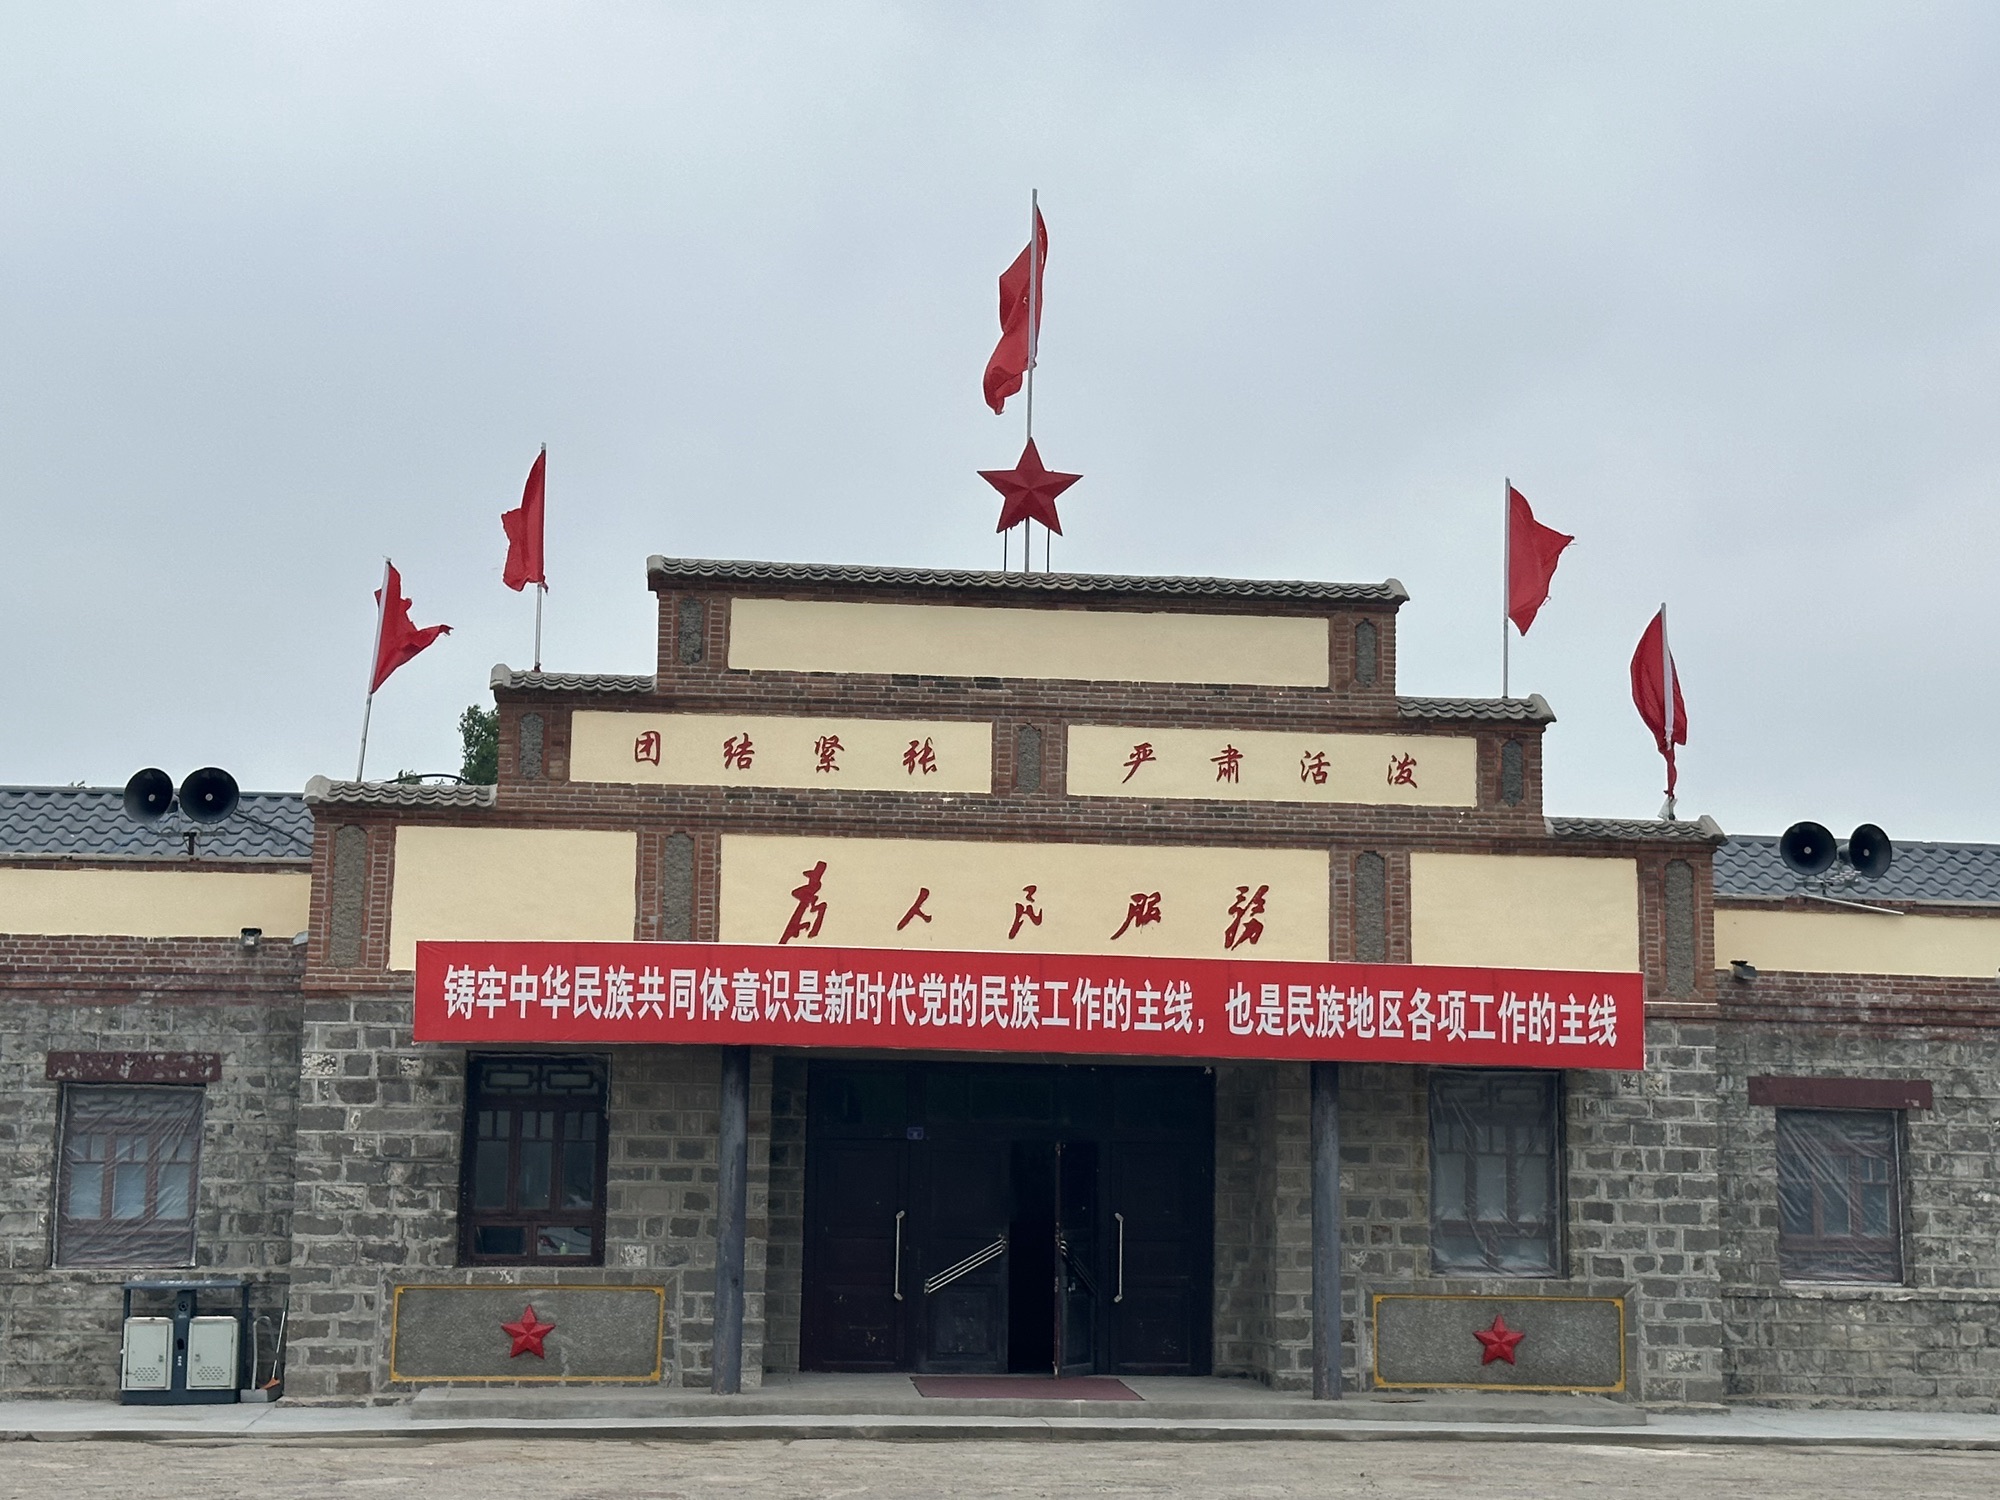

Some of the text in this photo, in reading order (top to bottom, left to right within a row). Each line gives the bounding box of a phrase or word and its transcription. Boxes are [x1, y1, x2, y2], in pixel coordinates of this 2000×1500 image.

[635, 731, 938, 775] 团结紧张
[1121, 742, 1418, 788] 严肃活泼
